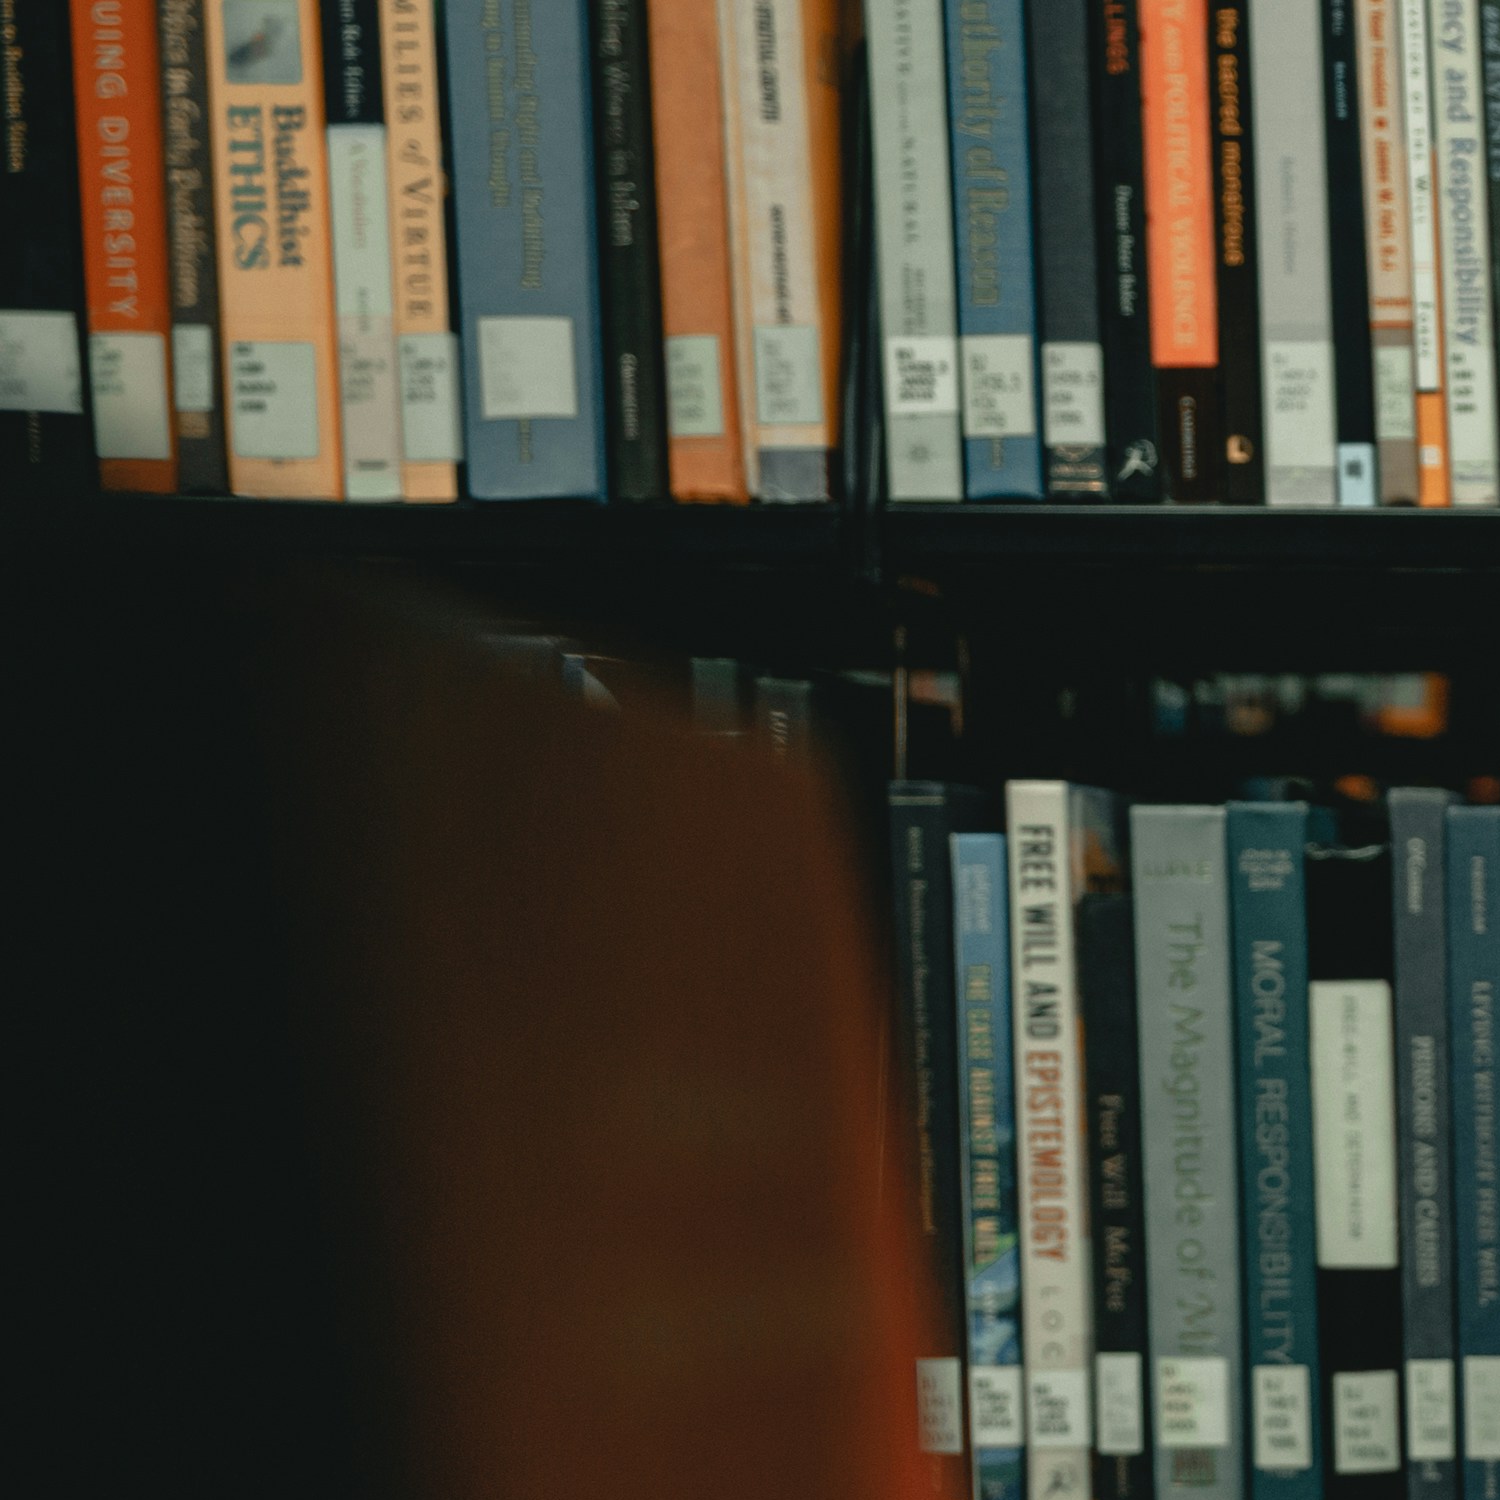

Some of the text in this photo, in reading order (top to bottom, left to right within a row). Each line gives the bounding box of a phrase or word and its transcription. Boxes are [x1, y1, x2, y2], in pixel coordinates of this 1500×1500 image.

[225, 103, 270, 271] ETHICS
[271, 103, 312, 269] Buddhist
[963, 147, 1009, 186] of
[1216, 8, 1246, 268] the sacred monstrous
[1444, 68, 1478, 123] and
[97, 116, 139, 319] DIVERSITY
[967, 187, 1009, 306] Reason
[1165, 72, 1199, 347] POLITICAL VIOLENCE
[1447, 137, 1487, 347] Responsibility
[1018, 825, 1071, 1264] FREE WILL AND EPISTEMOLOGY
[1160, 916, 1218, 1283] The Magnitude of
[1251, 940, 1297, 1364] MORAL RESPONSIBILITY
